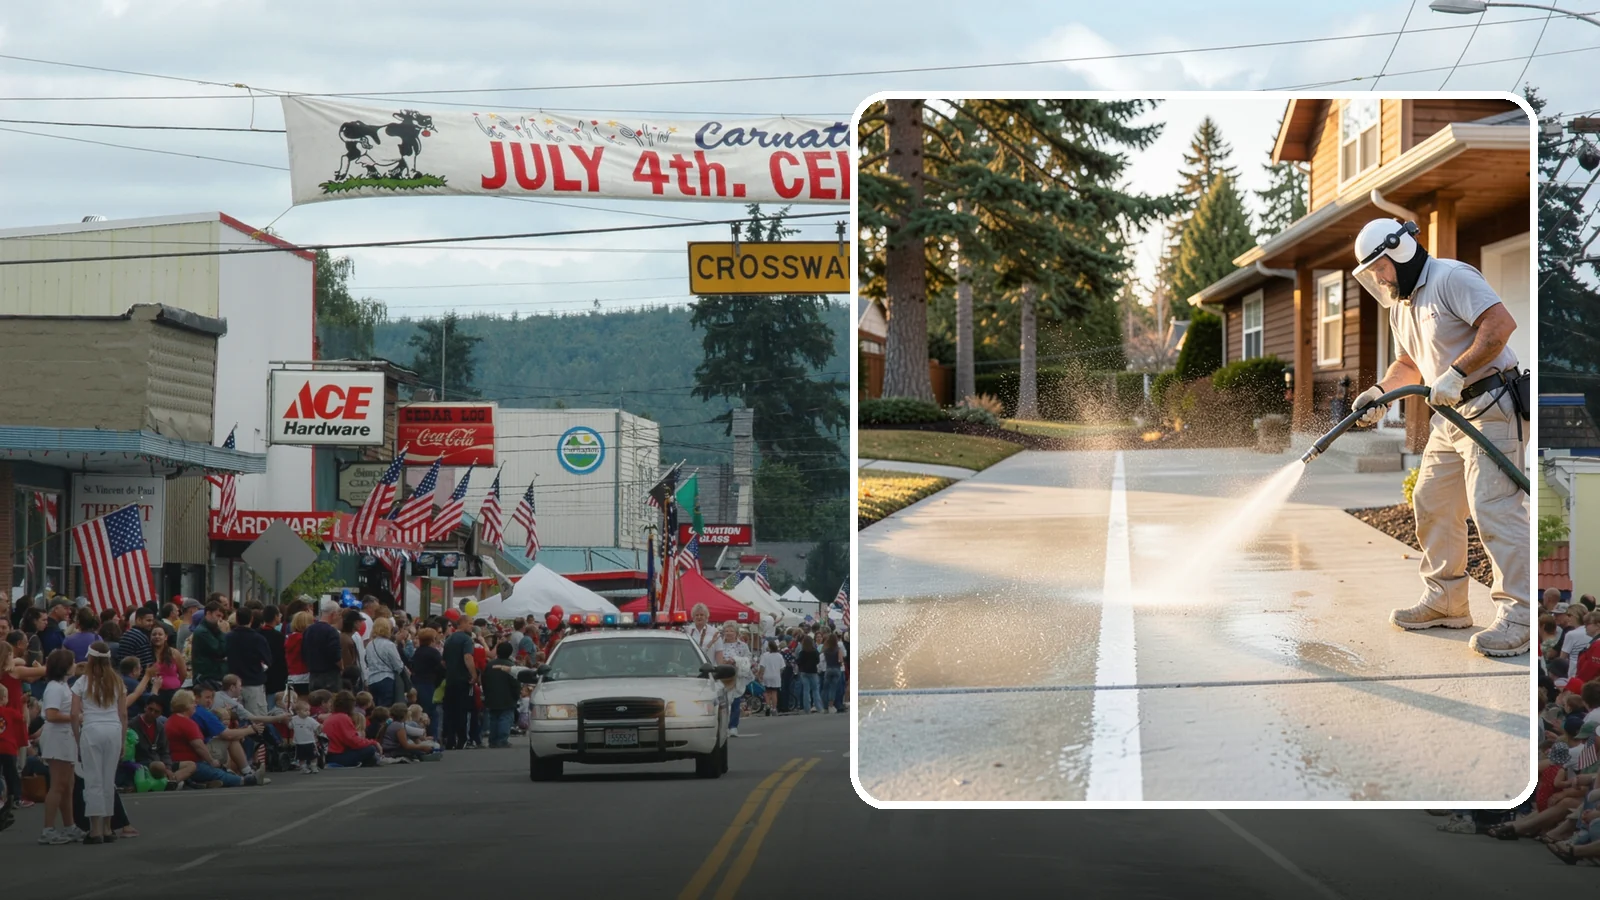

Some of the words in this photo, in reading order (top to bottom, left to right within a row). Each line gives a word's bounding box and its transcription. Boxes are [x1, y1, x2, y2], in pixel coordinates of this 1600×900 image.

[481, 141, 605, 192] JULY
[632, 150, 747, 197] 4th.
[282, 380, 373, 420] ACE
[406, 409, 453, 421] CEDAR
[461, 409, 485, 421] LOG
[283, 421, 371, 436] Hardware
[416, 428, 477, 447] Coca-Cola
[95, 485, 124, 495] Vincent
[126, 486, 136, 495] de
[137, 486, 155, 495] Paul
[687, 526, 741, 535] CRNATION
[699, 535, 730, 543] GLASS
